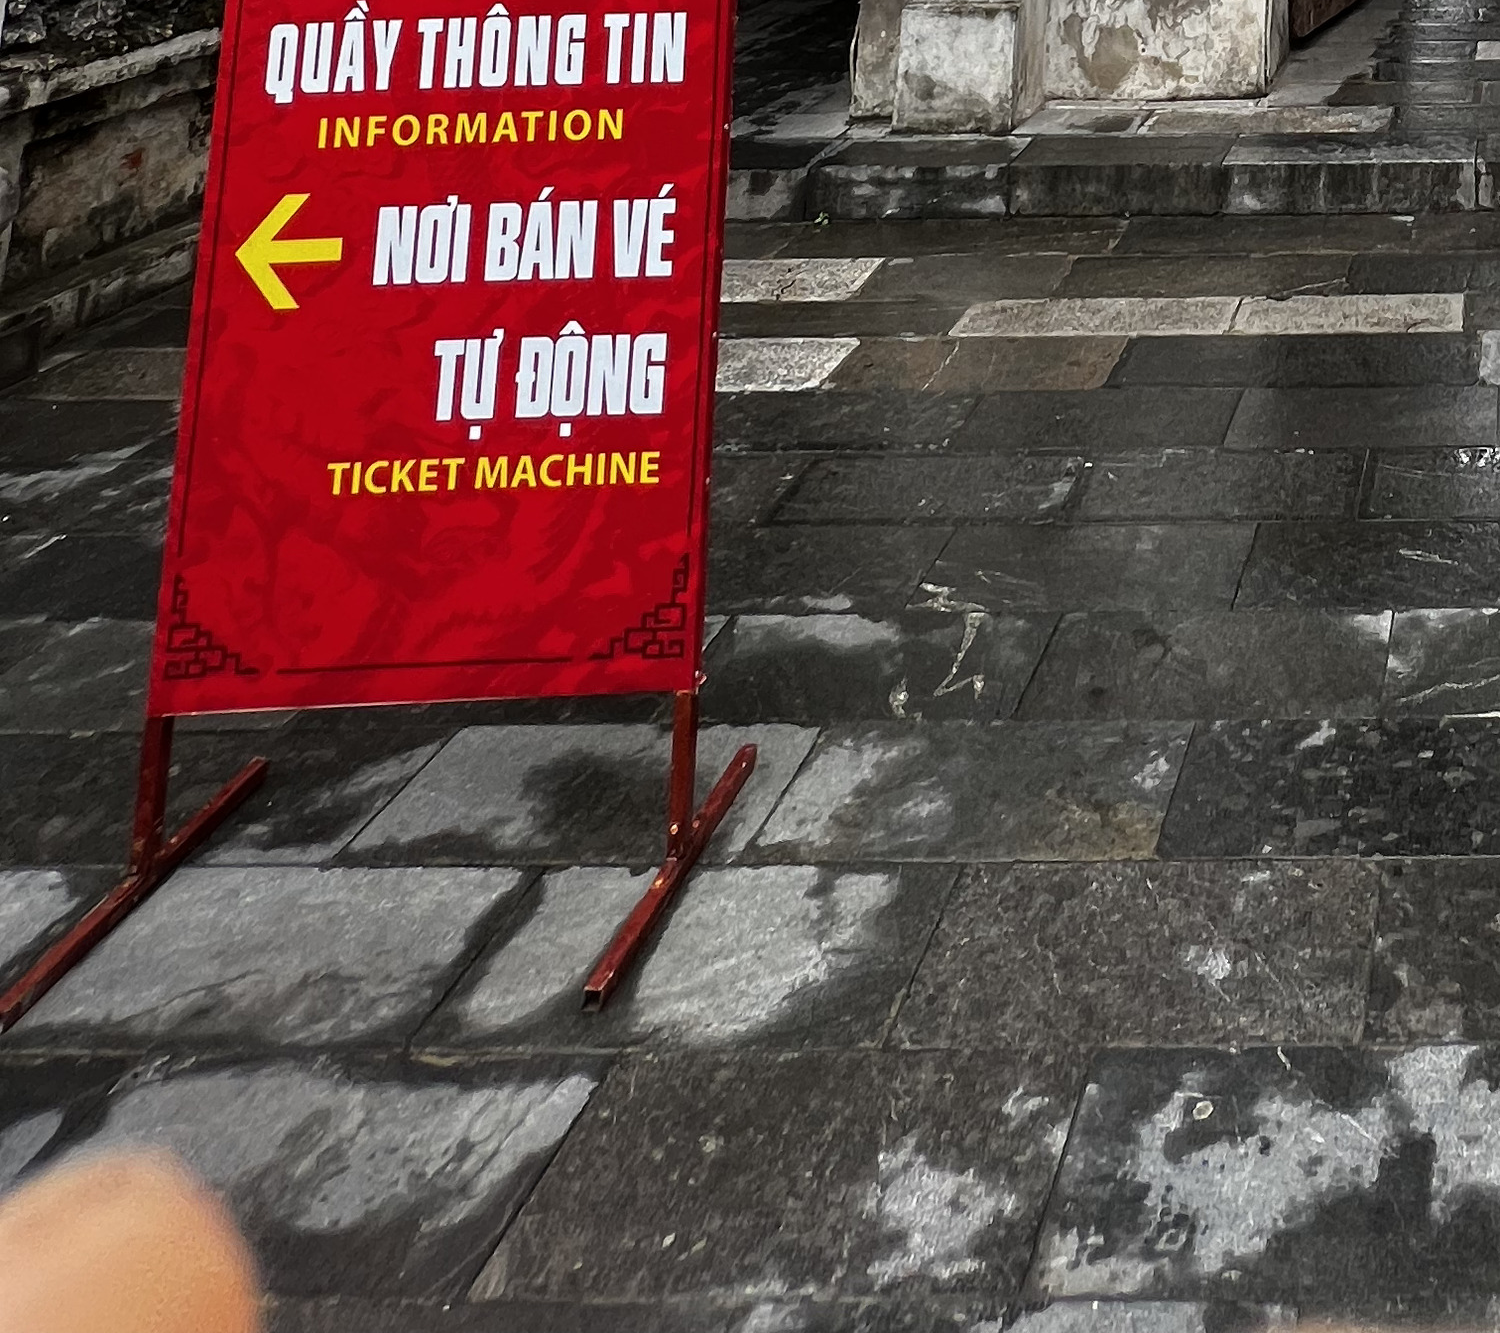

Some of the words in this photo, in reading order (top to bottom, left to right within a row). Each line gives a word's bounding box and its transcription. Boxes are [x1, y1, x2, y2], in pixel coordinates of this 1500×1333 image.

[264, 0, 403, 104] QUẦY
[417, 3, 588, 90] THÔNG
[603, 12, 688, 85] TIN
[317, 108, 624, 148] INFORMATION
[372, 194, 472, 286] NƠI
[484, 186, 598, 282] BÁN
[613, 183, 677, 278] VÉ
[434, 328, 505, 440] TỰ
[515, 320, 667, 438] ĐỘNG
[327, 457, 466, 496] TICKET
[474, 451, 661, 490] MACHINE
